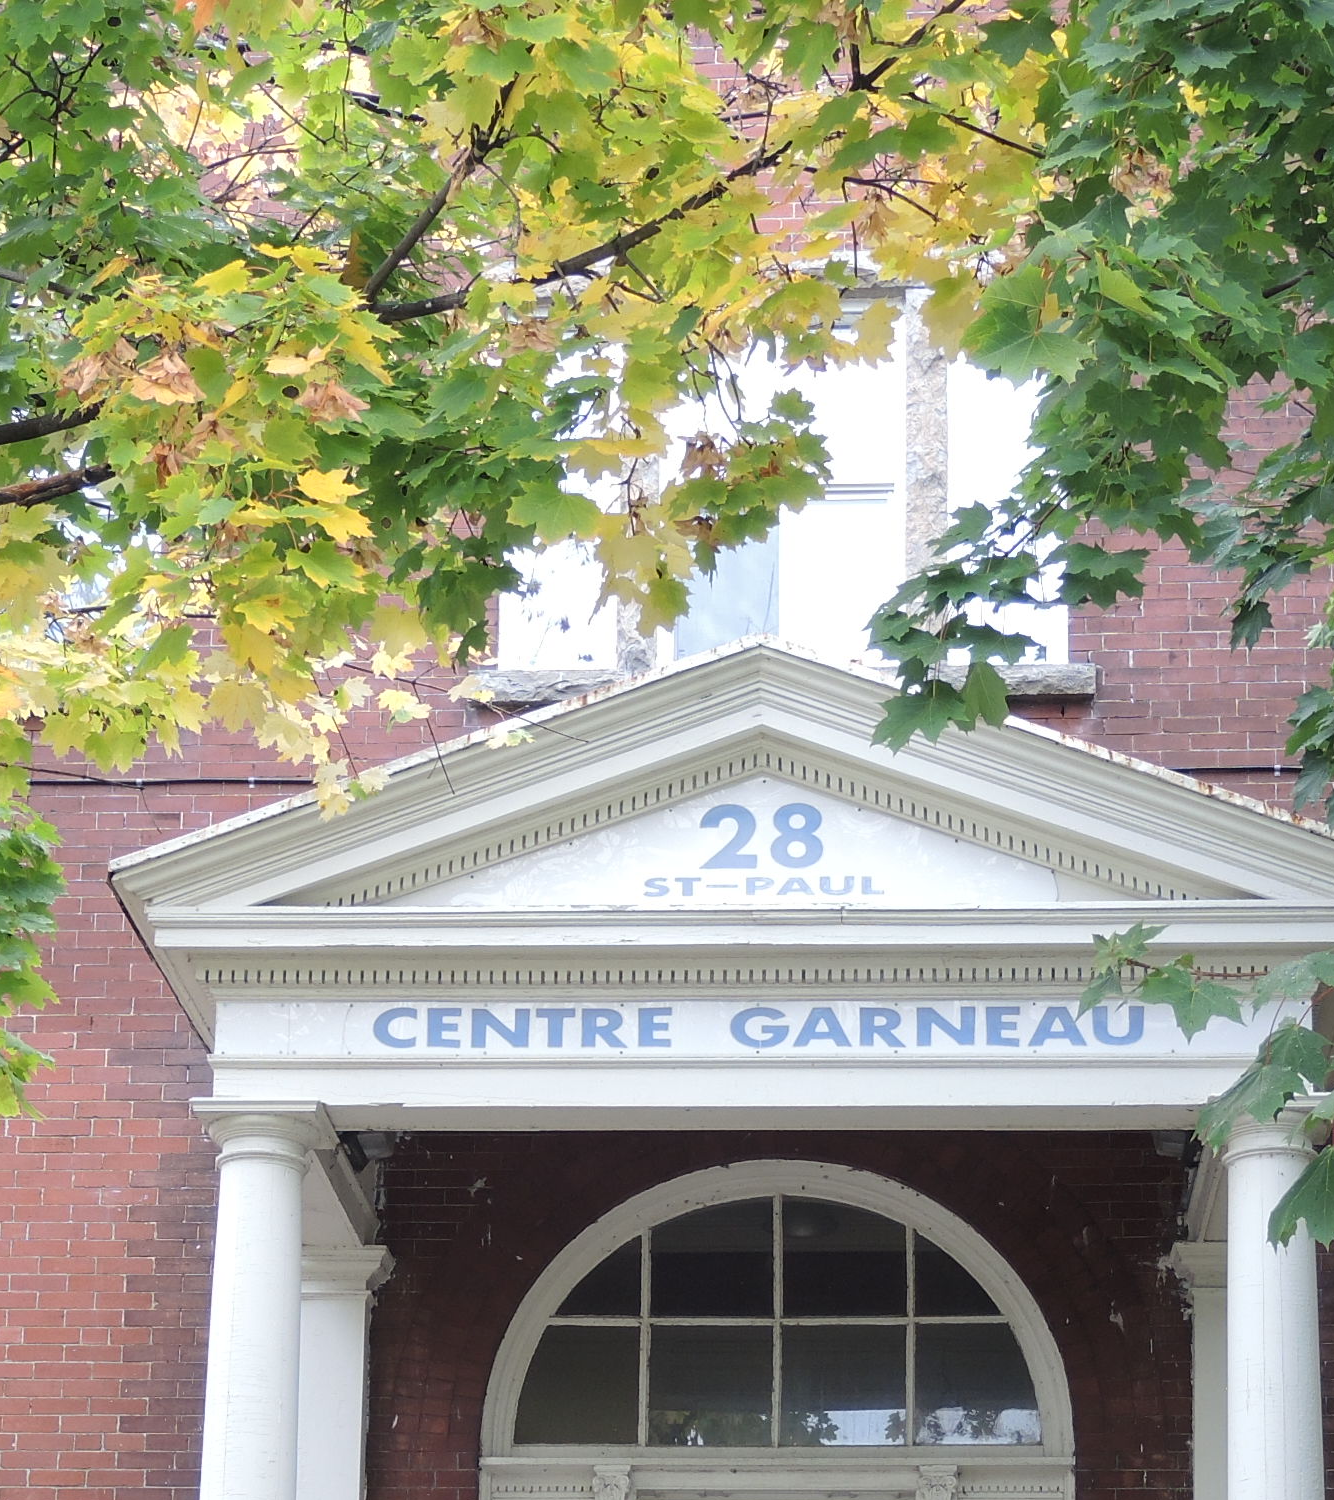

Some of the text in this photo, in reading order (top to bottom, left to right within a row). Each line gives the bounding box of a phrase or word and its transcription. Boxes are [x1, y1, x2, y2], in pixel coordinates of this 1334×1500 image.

[699, 803, 824, 870] 28
[644, 875, 886, 897] ST-PAUL
[373, 1006, 1145, 1050] CENTRE GARNEAU
